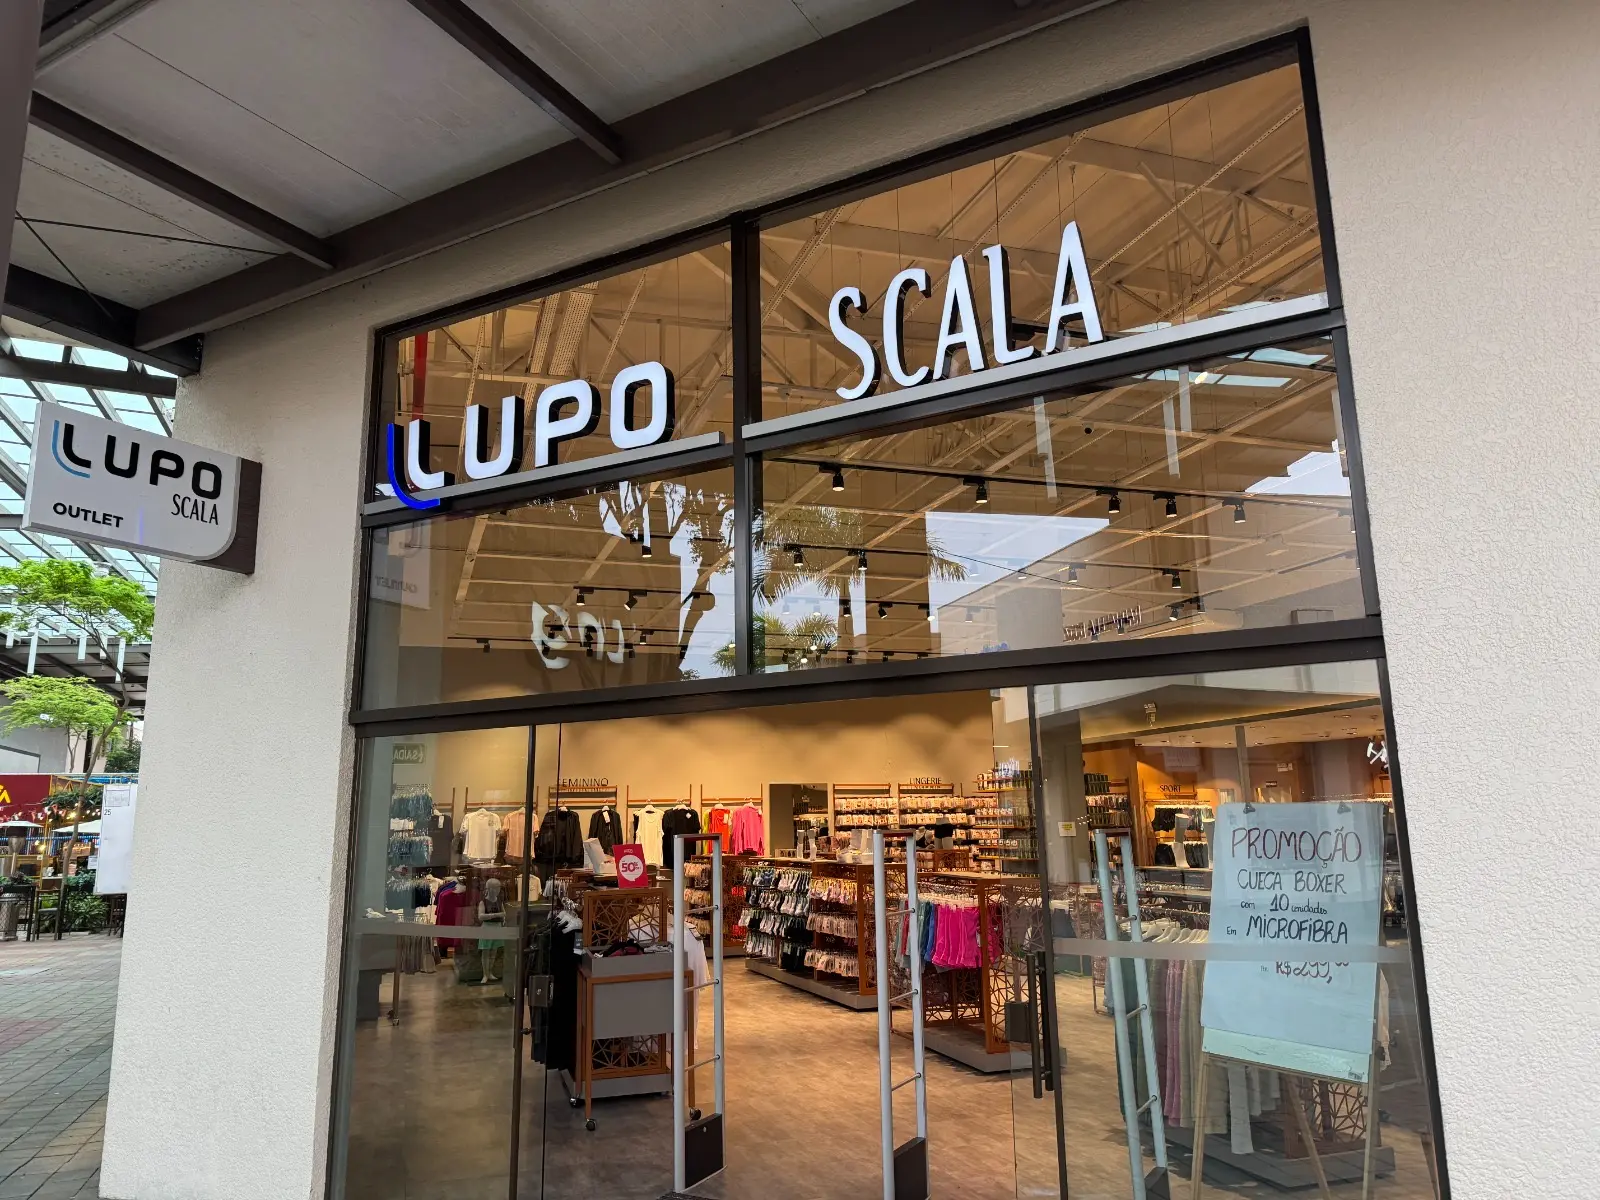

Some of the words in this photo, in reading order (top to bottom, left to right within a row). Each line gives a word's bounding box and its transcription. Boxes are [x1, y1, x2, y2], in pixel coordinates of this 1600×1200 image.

[826, 220, 1105, 401] SCALA
[406, 360, 675, 490] LUPO
[62, 422, 223, 500] LUPO
[52, 502, 124, 529] OUTLET
[171, 493, 219, 526] SCALA
[1159, 784, 1182, 793] SPORT
[1231, 826, 1362, 869] PROMOÇÃO
[1237, 868, 1283, 891] CUECA
[1293, 870, 1347, 894] BOXER
[1269, 893, 1290, 912] 10
[1291, 898, 1328, 915] unidades
